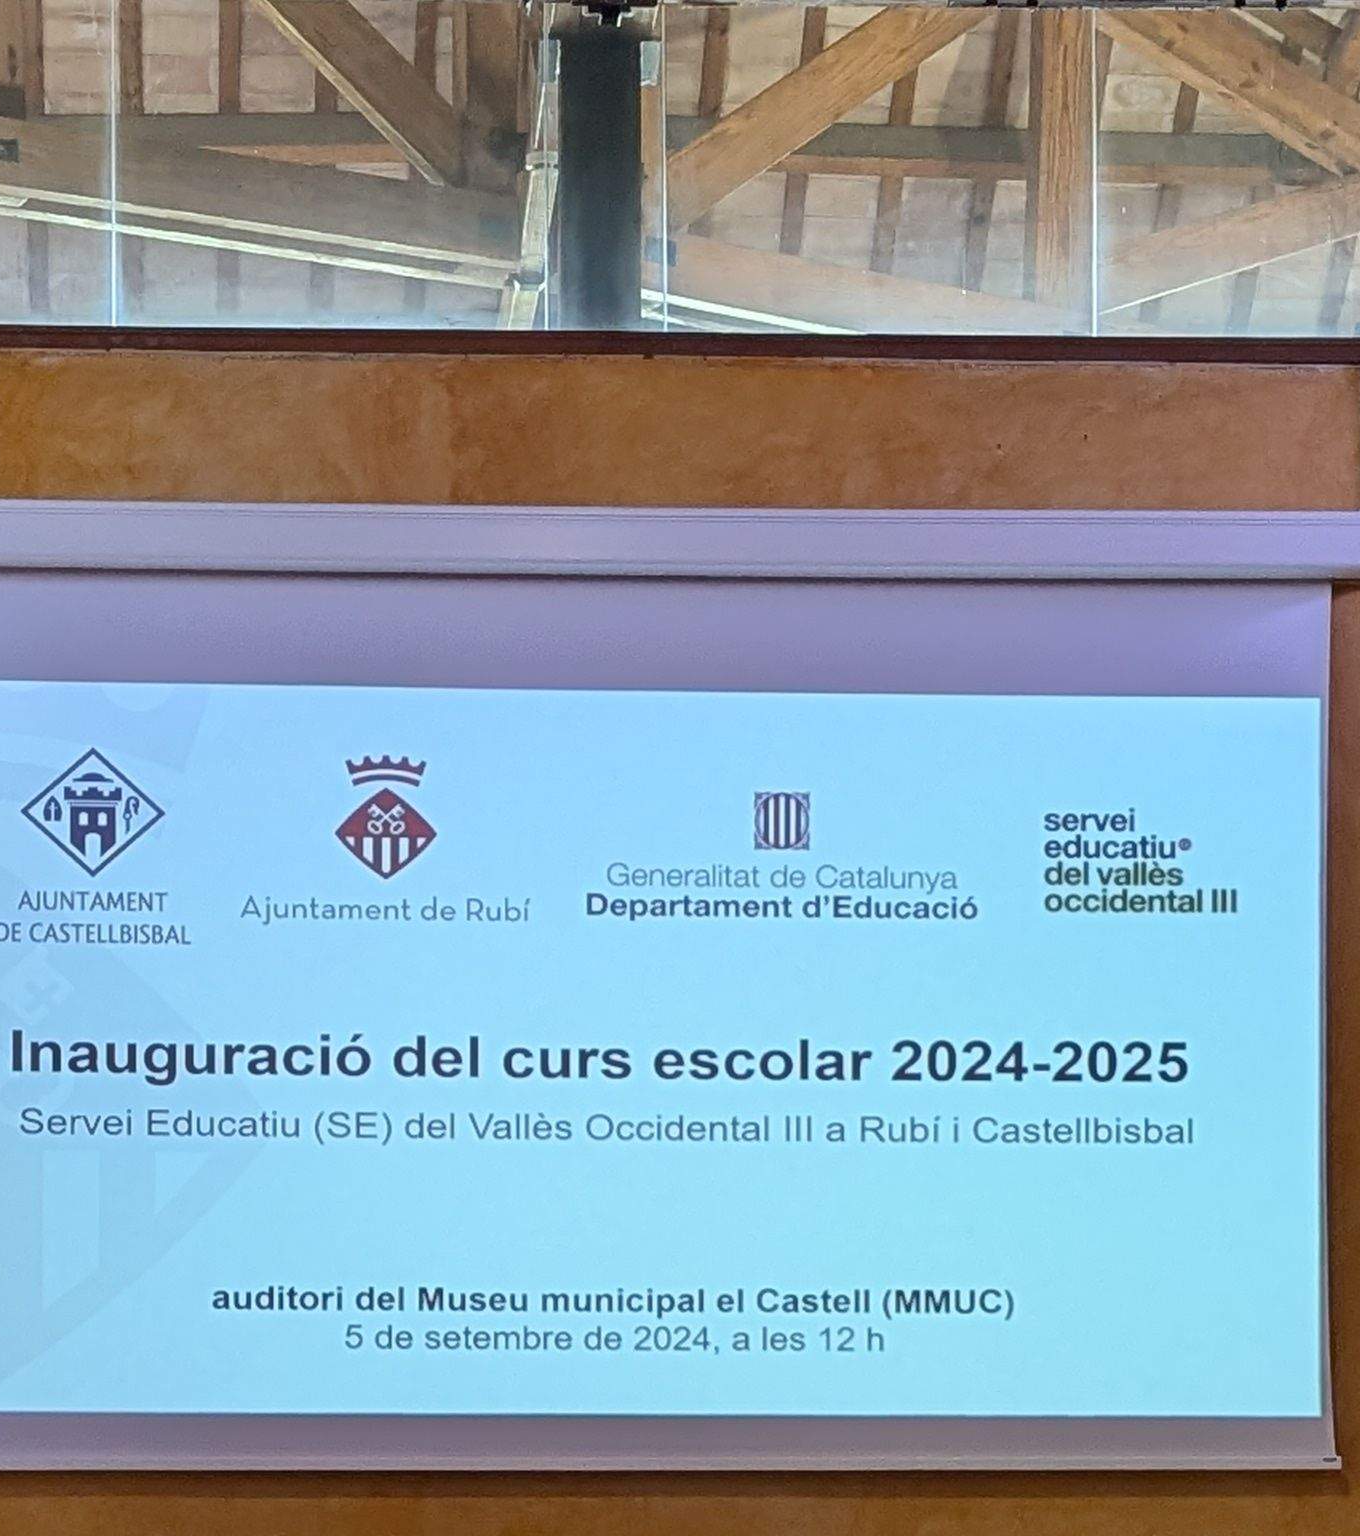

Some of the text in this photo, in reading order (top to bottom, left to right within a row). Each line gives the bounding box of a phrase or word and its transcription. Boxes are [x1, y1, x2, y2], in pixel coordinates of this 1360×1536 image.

[1043, 807, 1136, 833] servei
[606, 861, 959, 896] Generalitat de Catalunya
[1043, 860, 1184, 887] del vallès
[17, 889, 169, 913] AJUNTAMENT
[239, 894, 531, 926] Ajuntament de Rubí
[586, 892, 793, 922] Departament
[1043, 887, 1238, 914] occidental III
[28, 921, 192, 946] CASTELLBISBAL
[11, 1029, 1189, 1087] Inauguració del curs escolar 2024-2025
[19, 1106, 1194, 1147] Servei Educatiu (SE) del Vallès Occidental III a Rubí i Castellbisbal
[212, 1285, 1015, 1321] auditori del Museu municipal el Castell (MMUC)
[344, 1323, 885, 1356] 5 de setembre de 2024, a les 12 h
